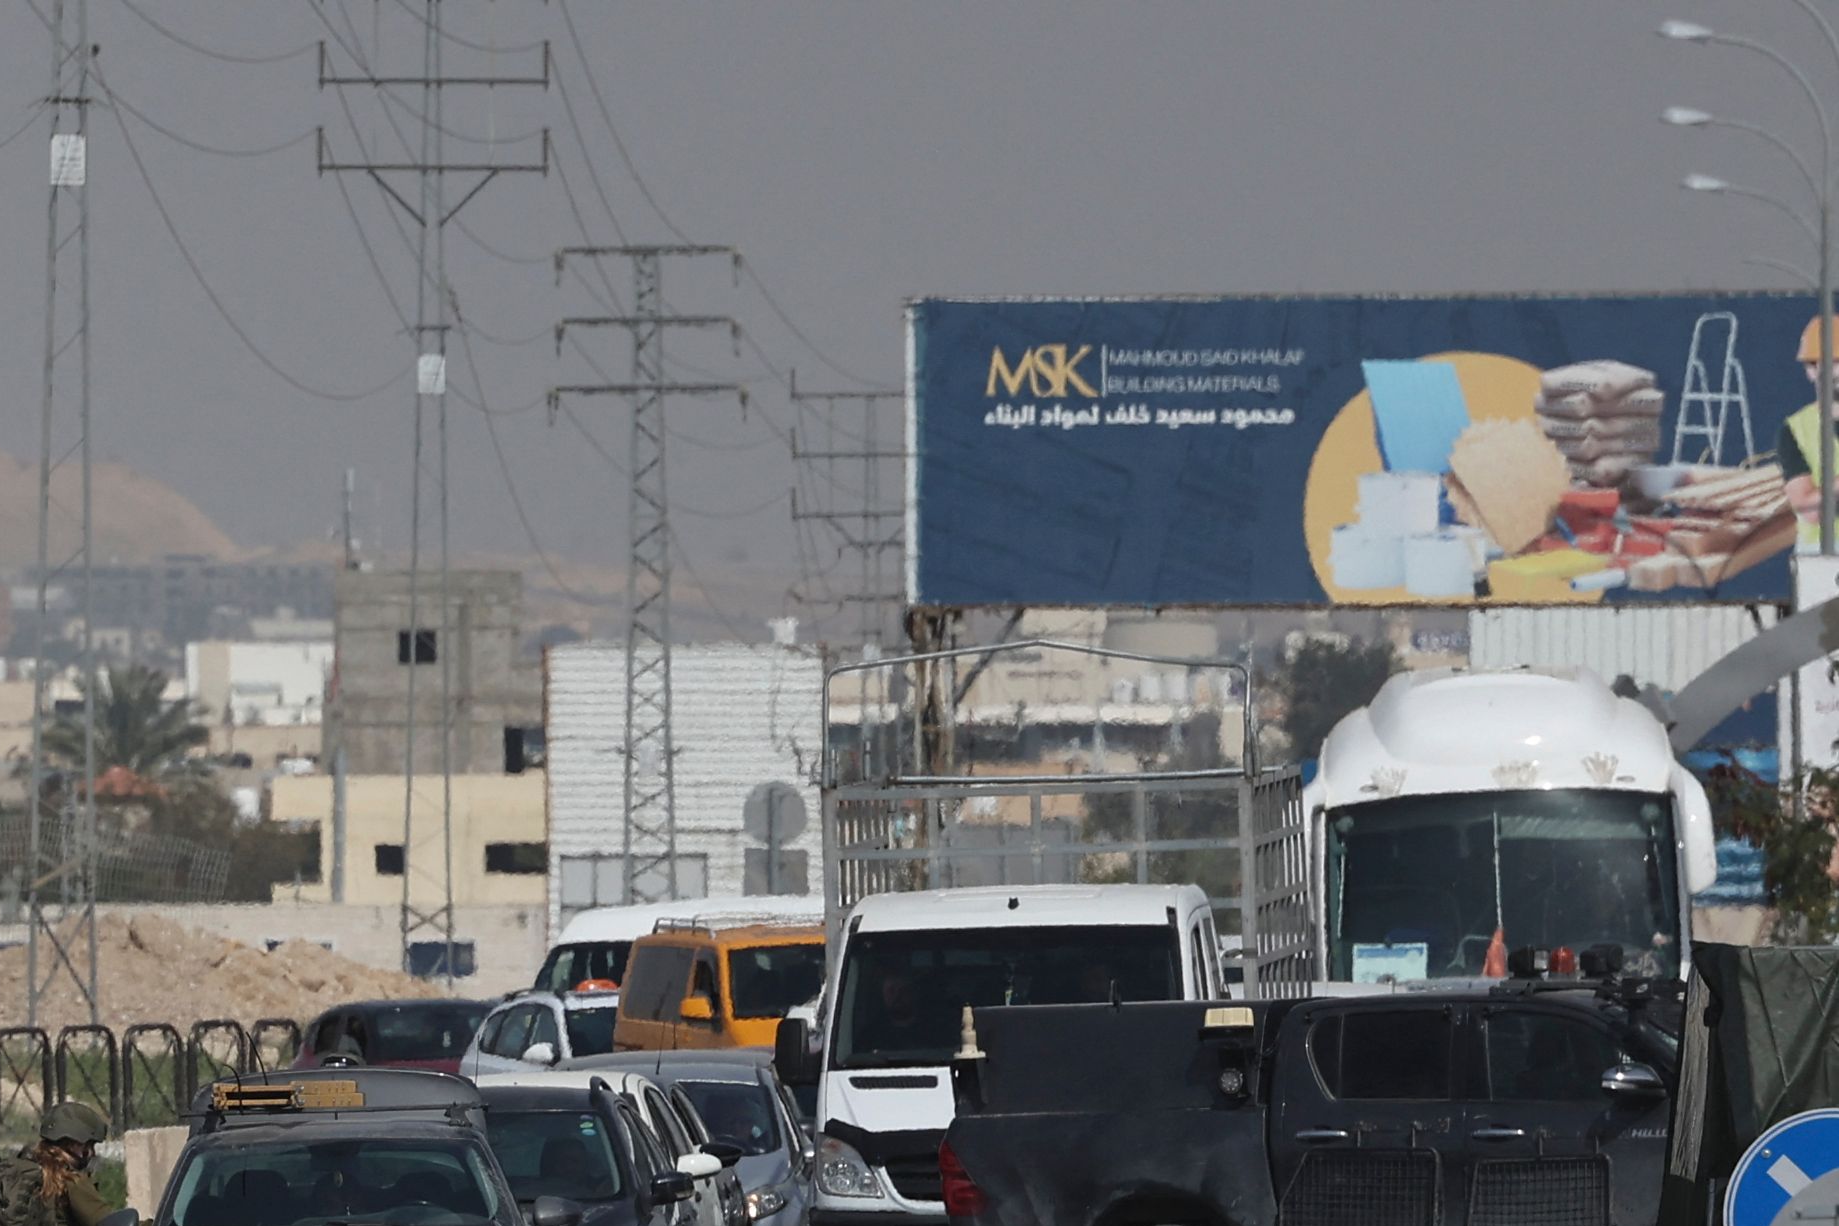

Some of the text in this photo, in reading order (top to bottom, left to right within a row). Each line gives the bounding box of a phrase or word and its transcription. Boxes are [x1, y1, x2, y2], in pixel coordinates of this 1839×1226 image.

[1109, 348, 1304, 366] MAHMOUD SAID KHALAF
[985, 343, 1099, 398] MSK
[1108, 374, 1281, 394] BUILDING MATERIALS
[984, 403, 1295, 429] محمود سعيد خلف لمواد البناء
